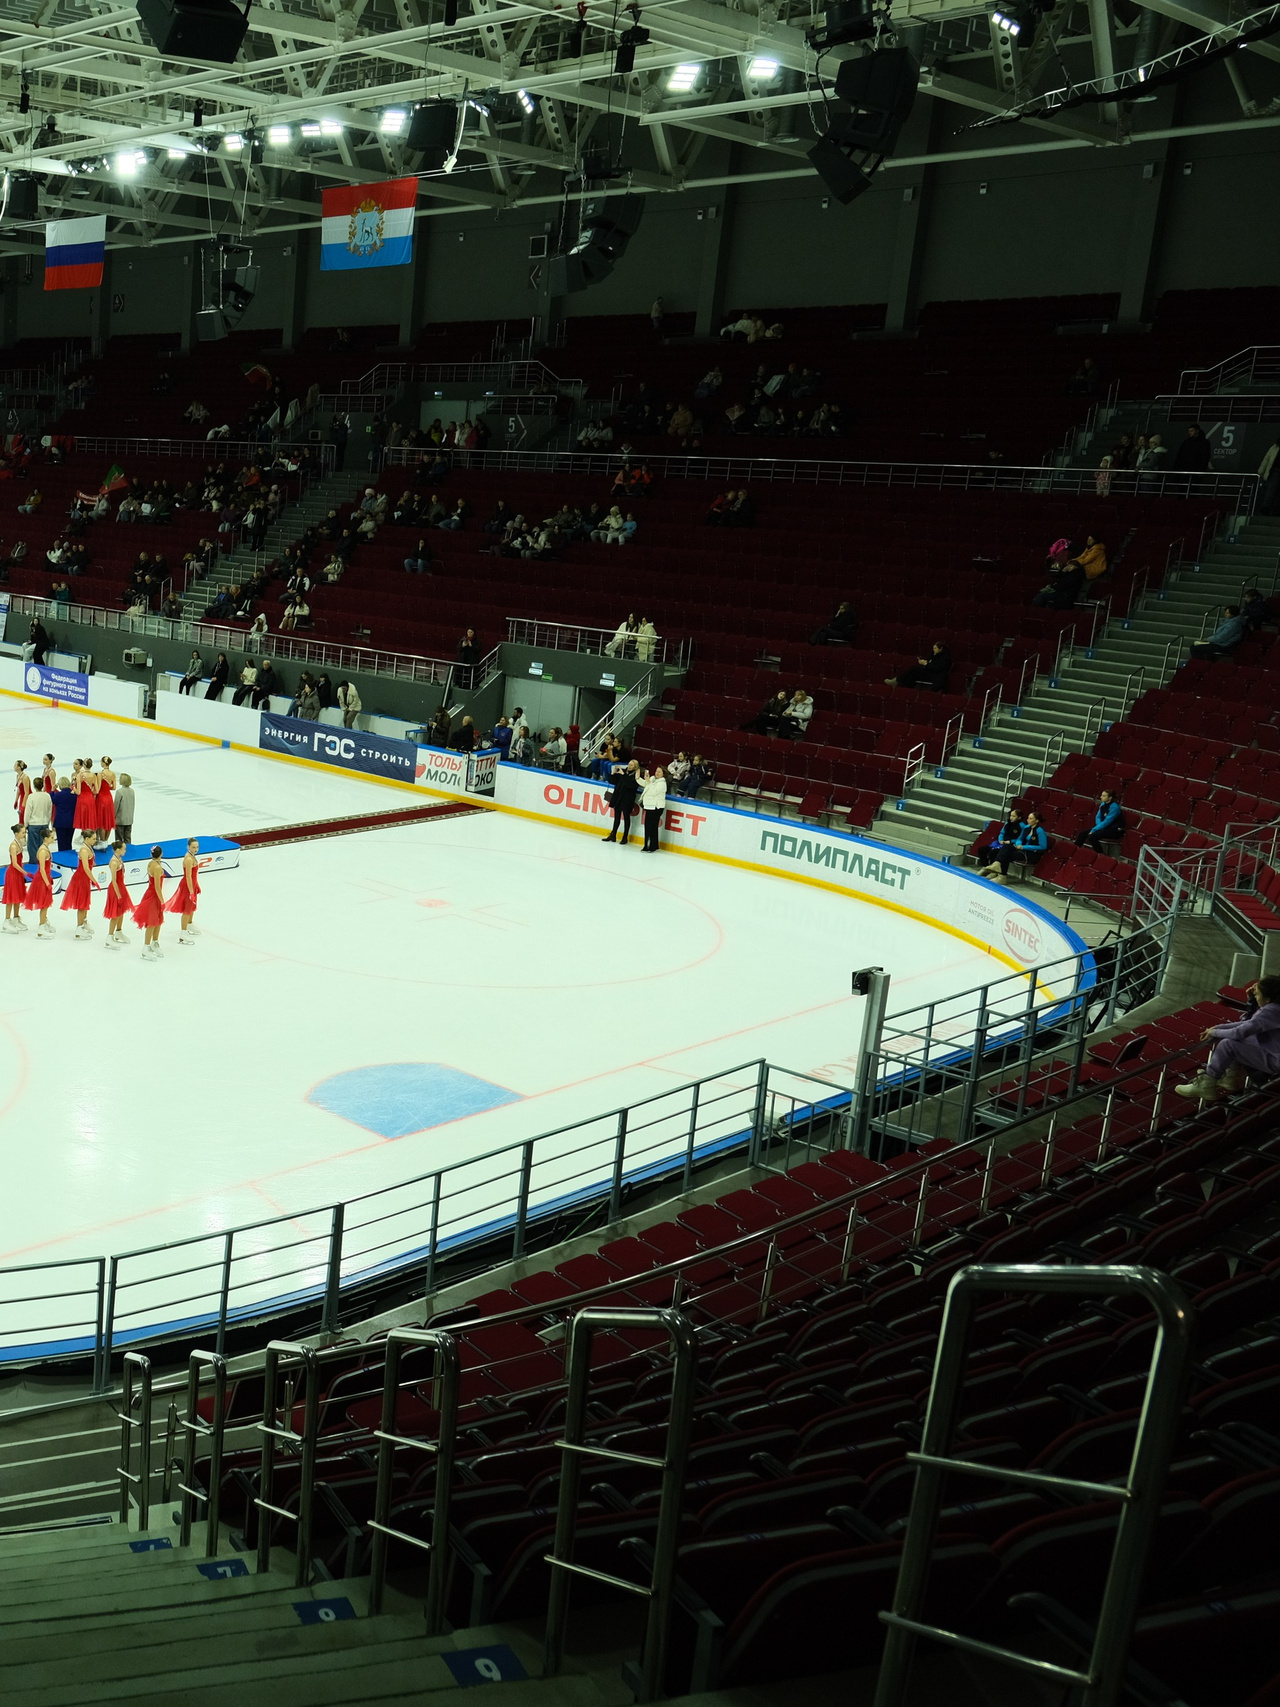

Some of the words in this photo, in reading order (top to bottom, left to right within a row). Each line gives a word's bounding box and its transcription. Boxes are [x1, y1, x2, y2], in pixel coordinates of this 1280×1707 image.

[508, 417, 516, 433] 5
[1221, 425, 1235, 448] 5
[264, 727, 308, 744] ЭНЕРГИЯ
[313, 732, 355, 759] ГЭС
[361, 747, 411, 767] СТРОИТЬ
[543, 783, 707, 837] OLIMET
[198, 857, 213, 868] 2
[760, 830, 911, 891] ПОЛИПЛАСТ
[968, 907, 995, 926] ANTIFREEZE
[970, 900, 987, 912] MOTOR
[1004, 918, 1040, 954] SINTEC
[474, 1657, 502, 1682] 9
